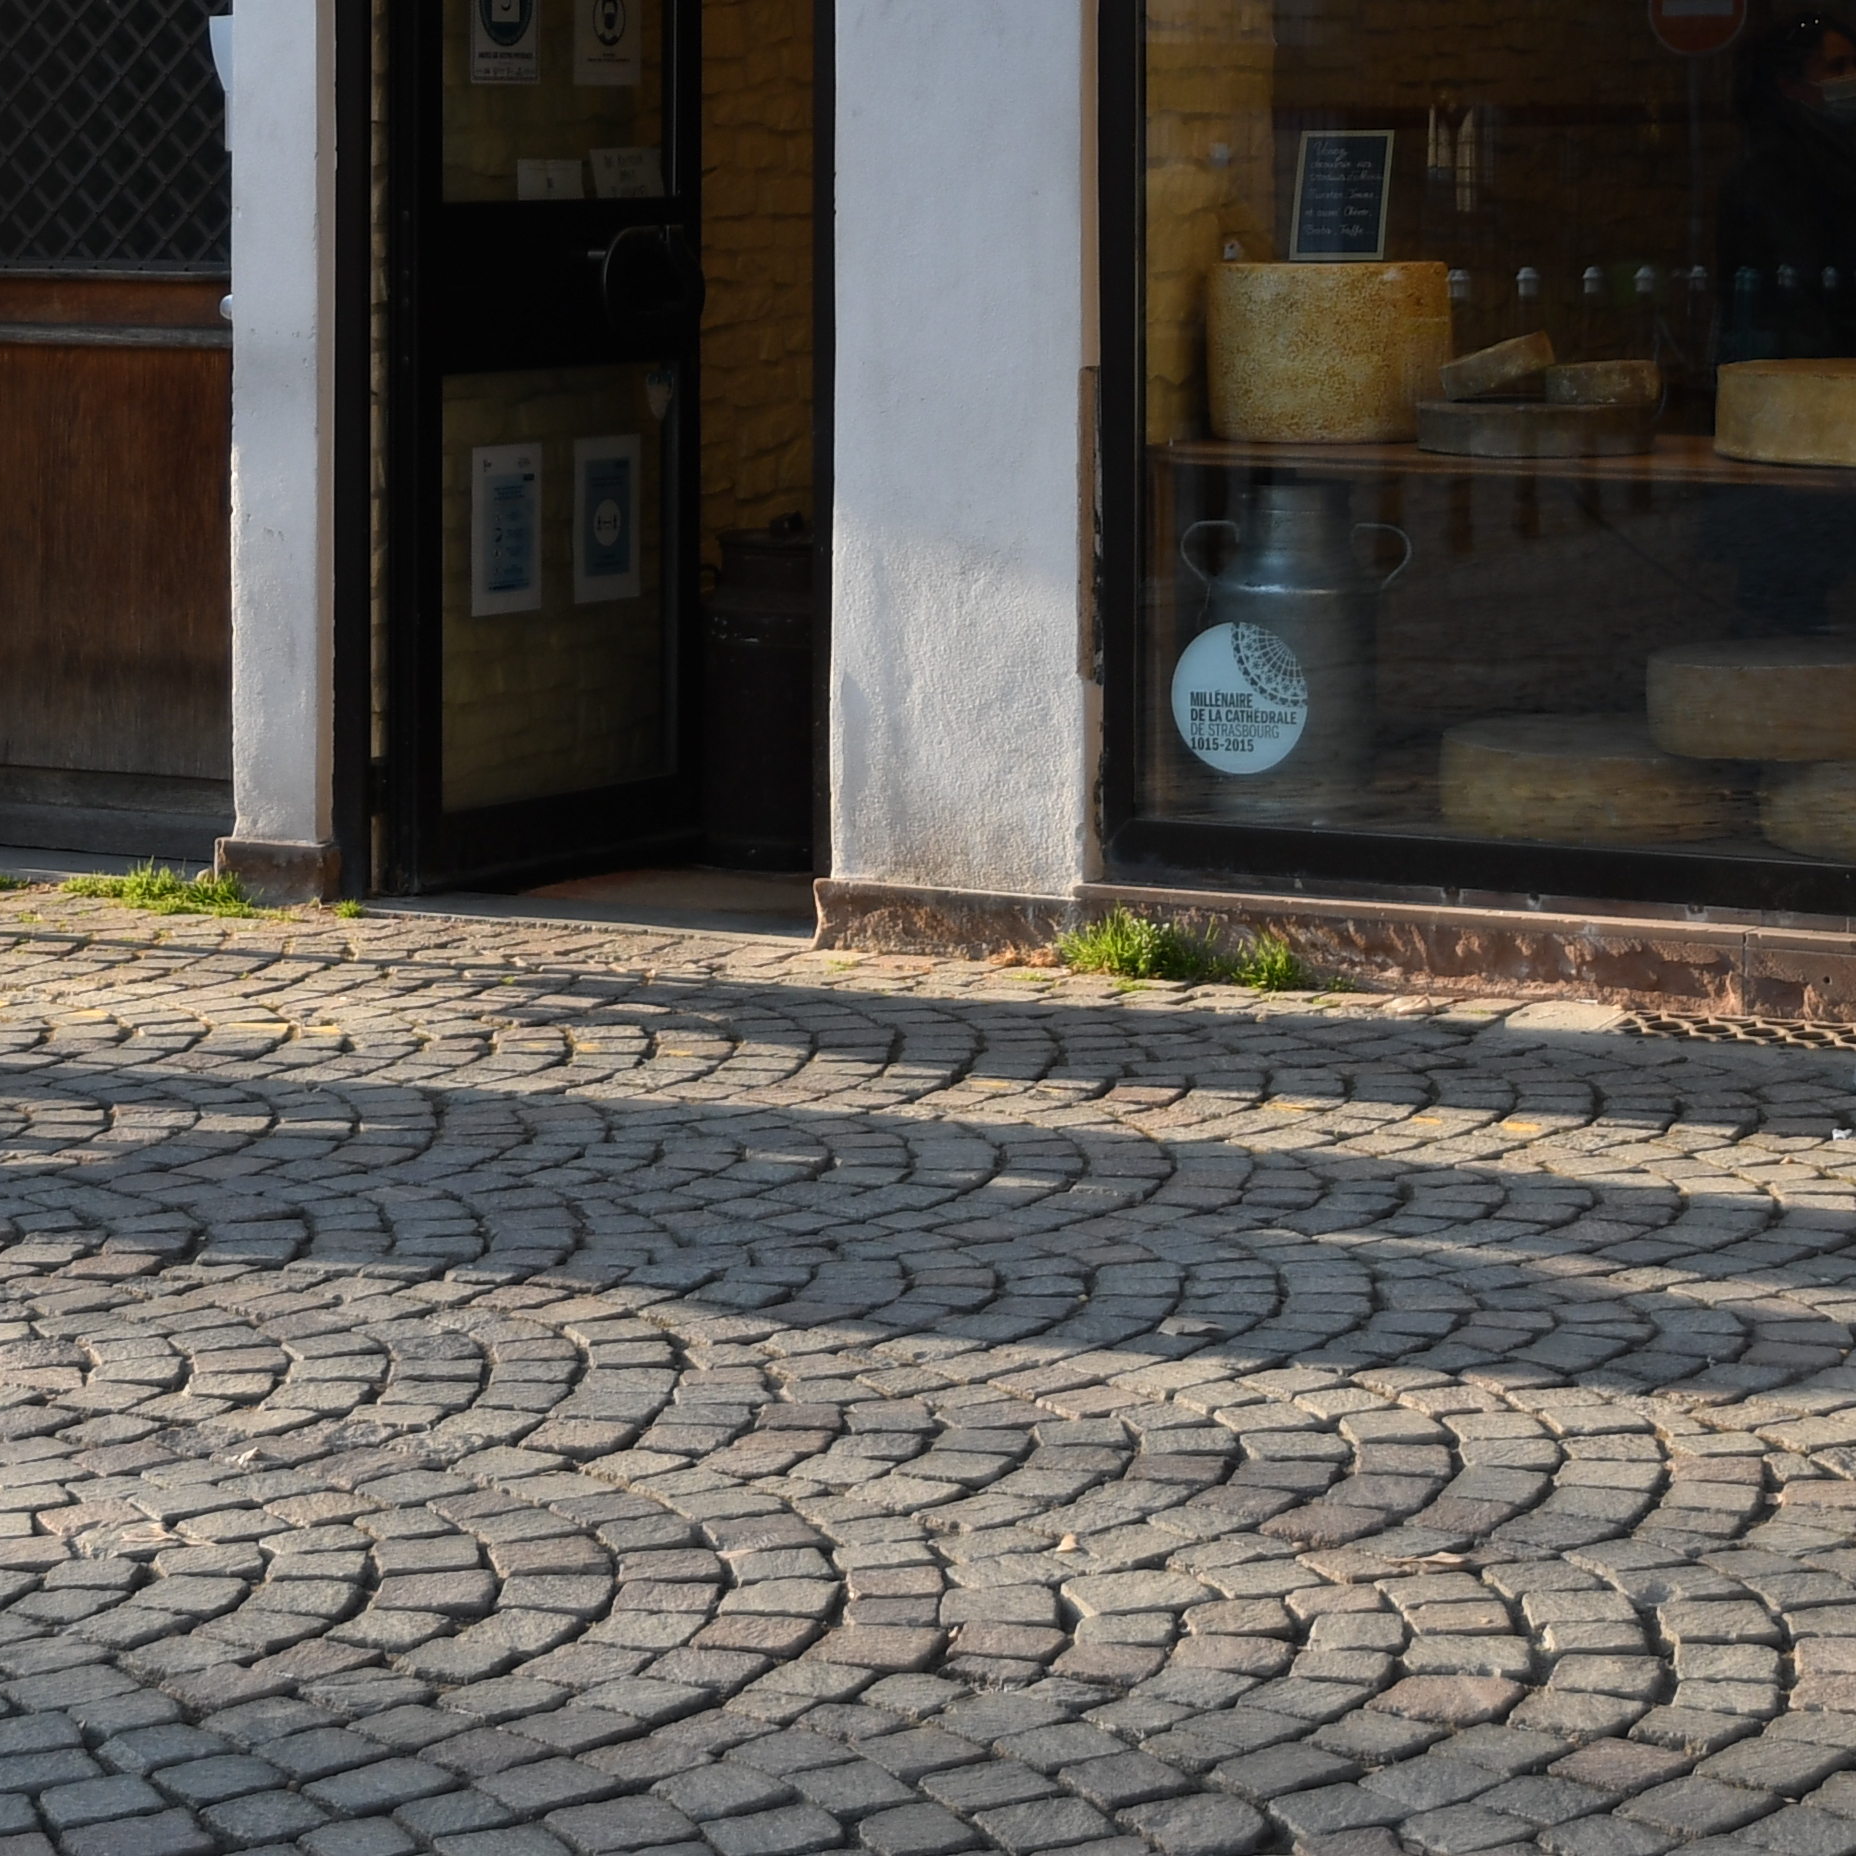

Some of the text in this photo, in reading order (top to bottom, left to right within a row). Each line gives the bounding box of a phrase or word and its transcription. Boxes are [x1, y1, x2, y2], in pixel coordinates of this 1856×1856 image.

[1190, 688, 1253, 708] MILLÉNAIRE
[1190, 706, 1297, 724] DE LA CATHÉDRALE
[1190, 722, 1280, 739] DE STRASBOURG
[1190, 737, 1254, 752] 1015-2015
